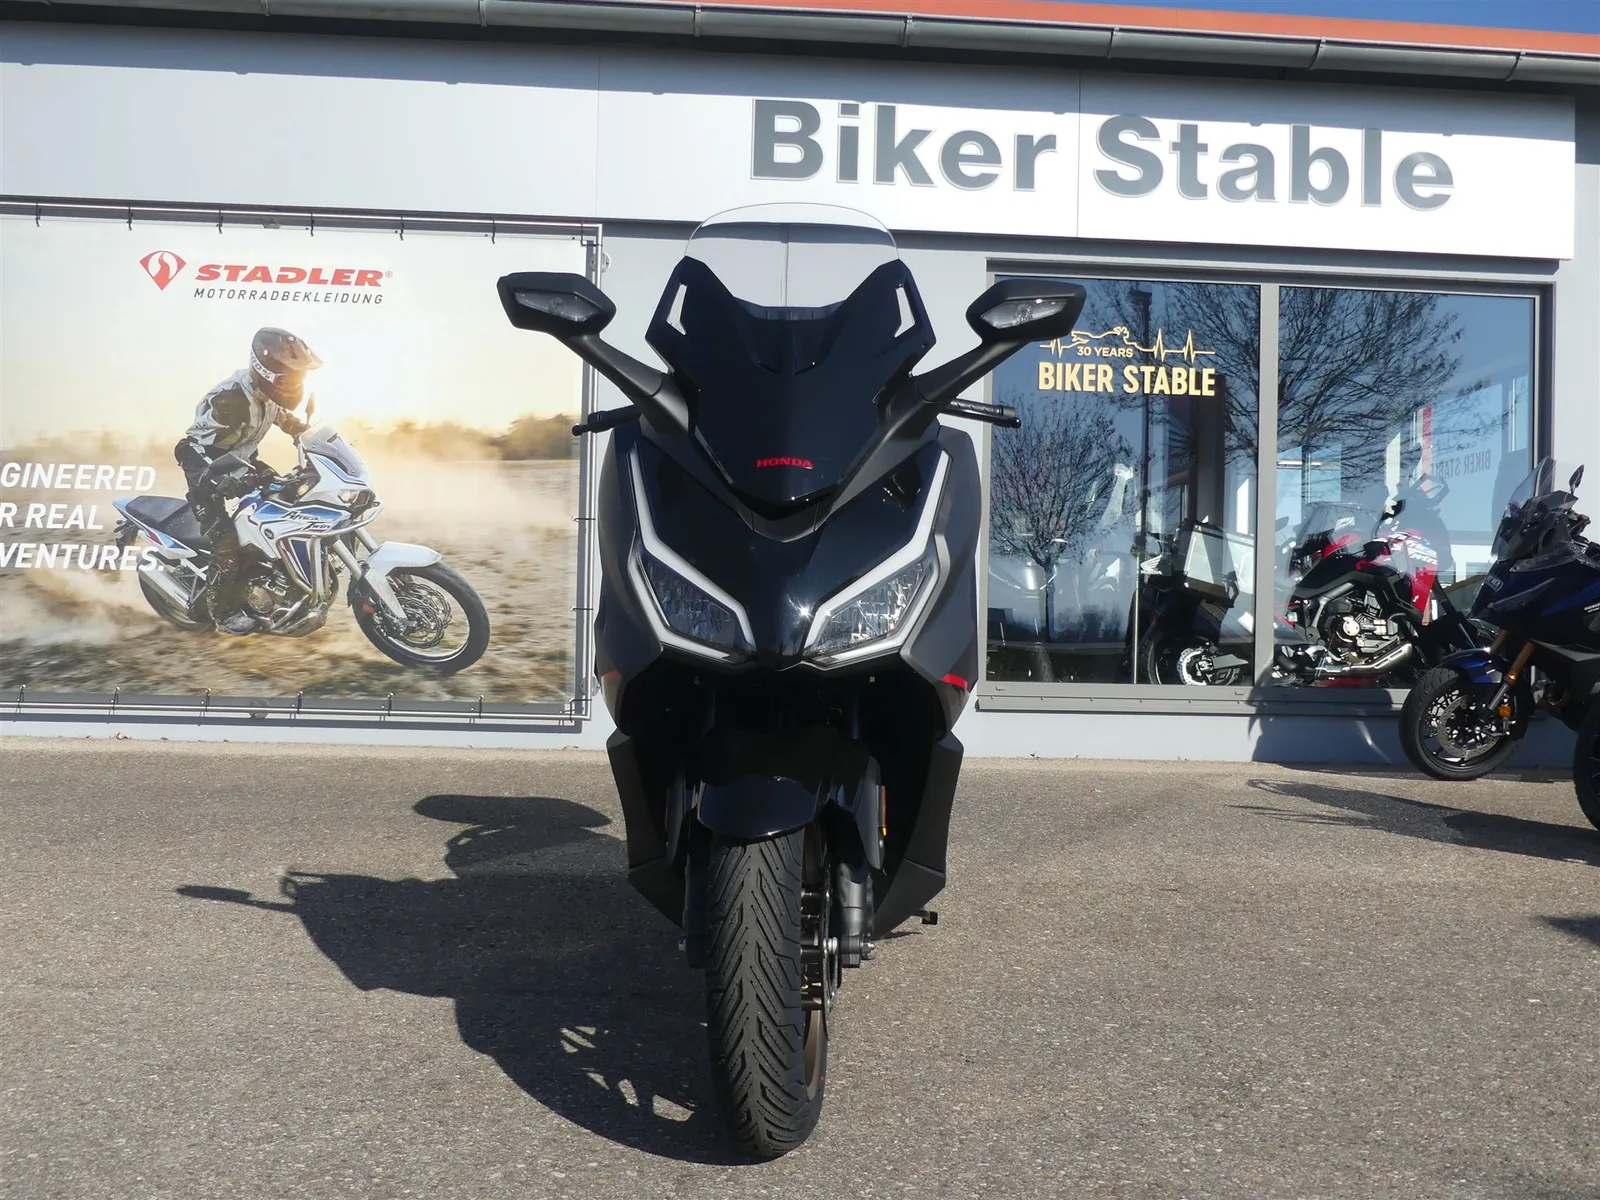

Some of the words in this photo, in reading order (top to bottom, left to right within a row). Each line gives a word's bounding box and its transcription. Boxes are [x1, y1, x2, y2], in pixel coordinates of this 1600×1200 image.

[750, 97, 1058, 192] Biker
[1093, 113, 1454, 211] Stable
[193, 288, 384, 304] MOTORRADBEKLEIDUNG
[1077, 346, 1092, 356] 30
[1095, 347, 1134, 358] YEARS
[1038, 361, 1114, 392] BIKER
[1123, 365, 1216, 397] STABLE
[0, 462, 156, 491] GINEERED
[756, 457, 814, 469] HONDA
[24, 503, 104, 530] REAL
